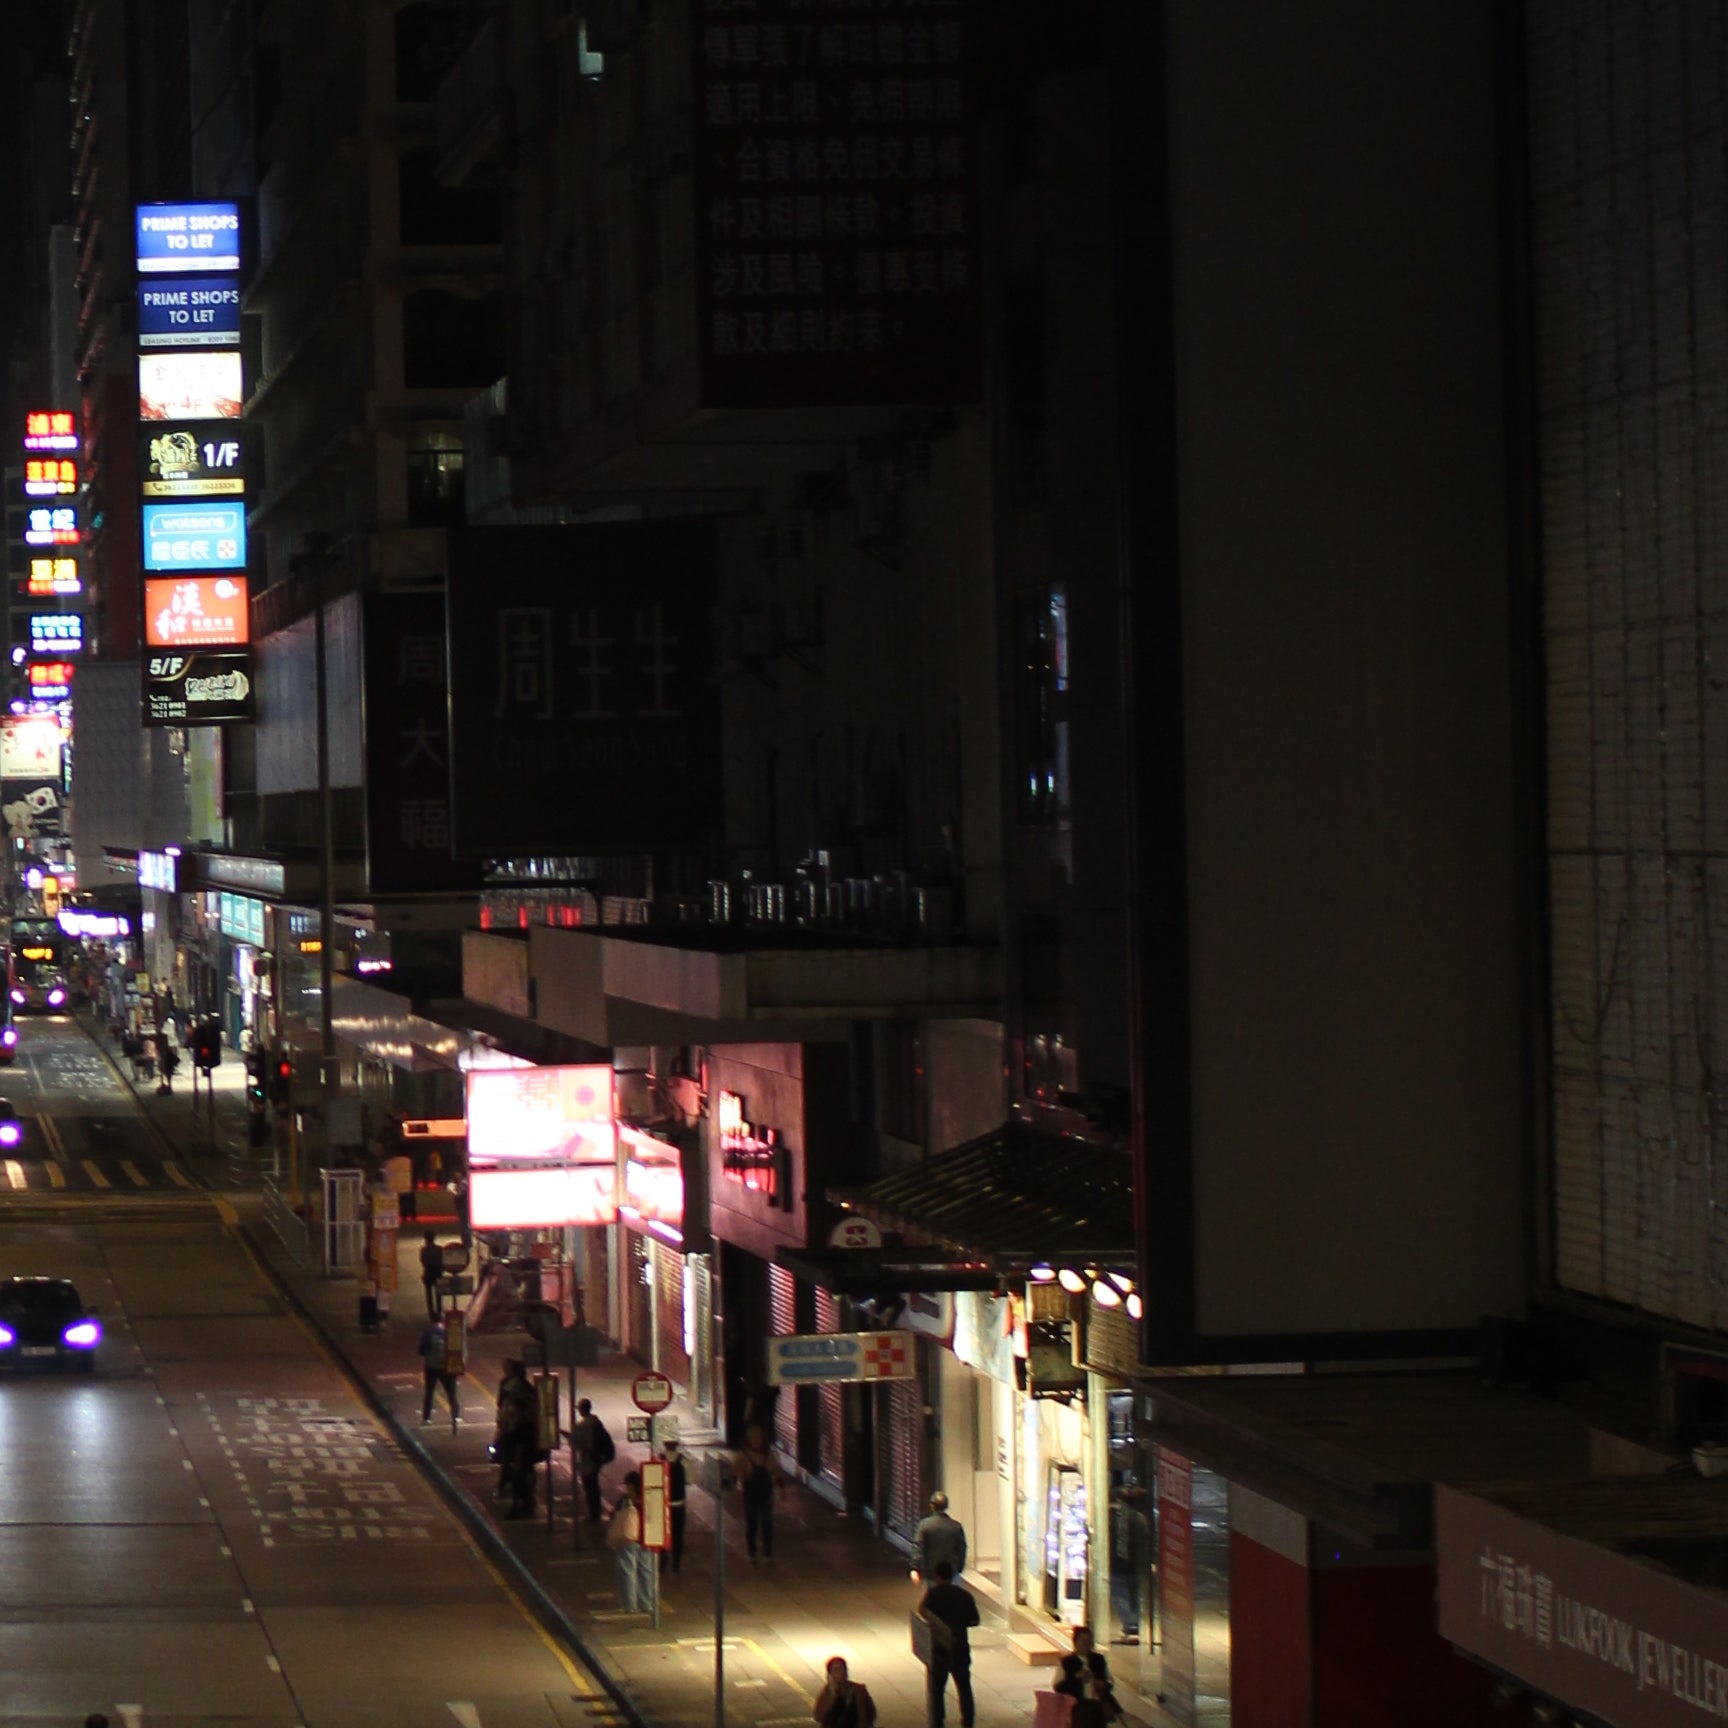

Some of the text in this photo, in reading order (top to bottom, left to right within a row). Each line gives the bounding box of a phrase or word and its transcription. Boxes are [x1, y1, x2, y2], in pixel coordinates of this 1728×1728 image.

[141, 215, 239, 231] PRIME SHOPS
[166, 234, 214, 249] TO LET
[144, 290, 239, 306] PRIME SHOPS
[169, 309, 215, 323] TO LET
[203, 442, 239, 468] 1/F
[160, 516, 225, 529] watsons
[149, 657, 183, 675] 5/F
[493, 607, 683, 719] 周生生
[397, 635, 449, 850] 周大福
[1480, 1545, 1554, 1651] 六福珠寶
